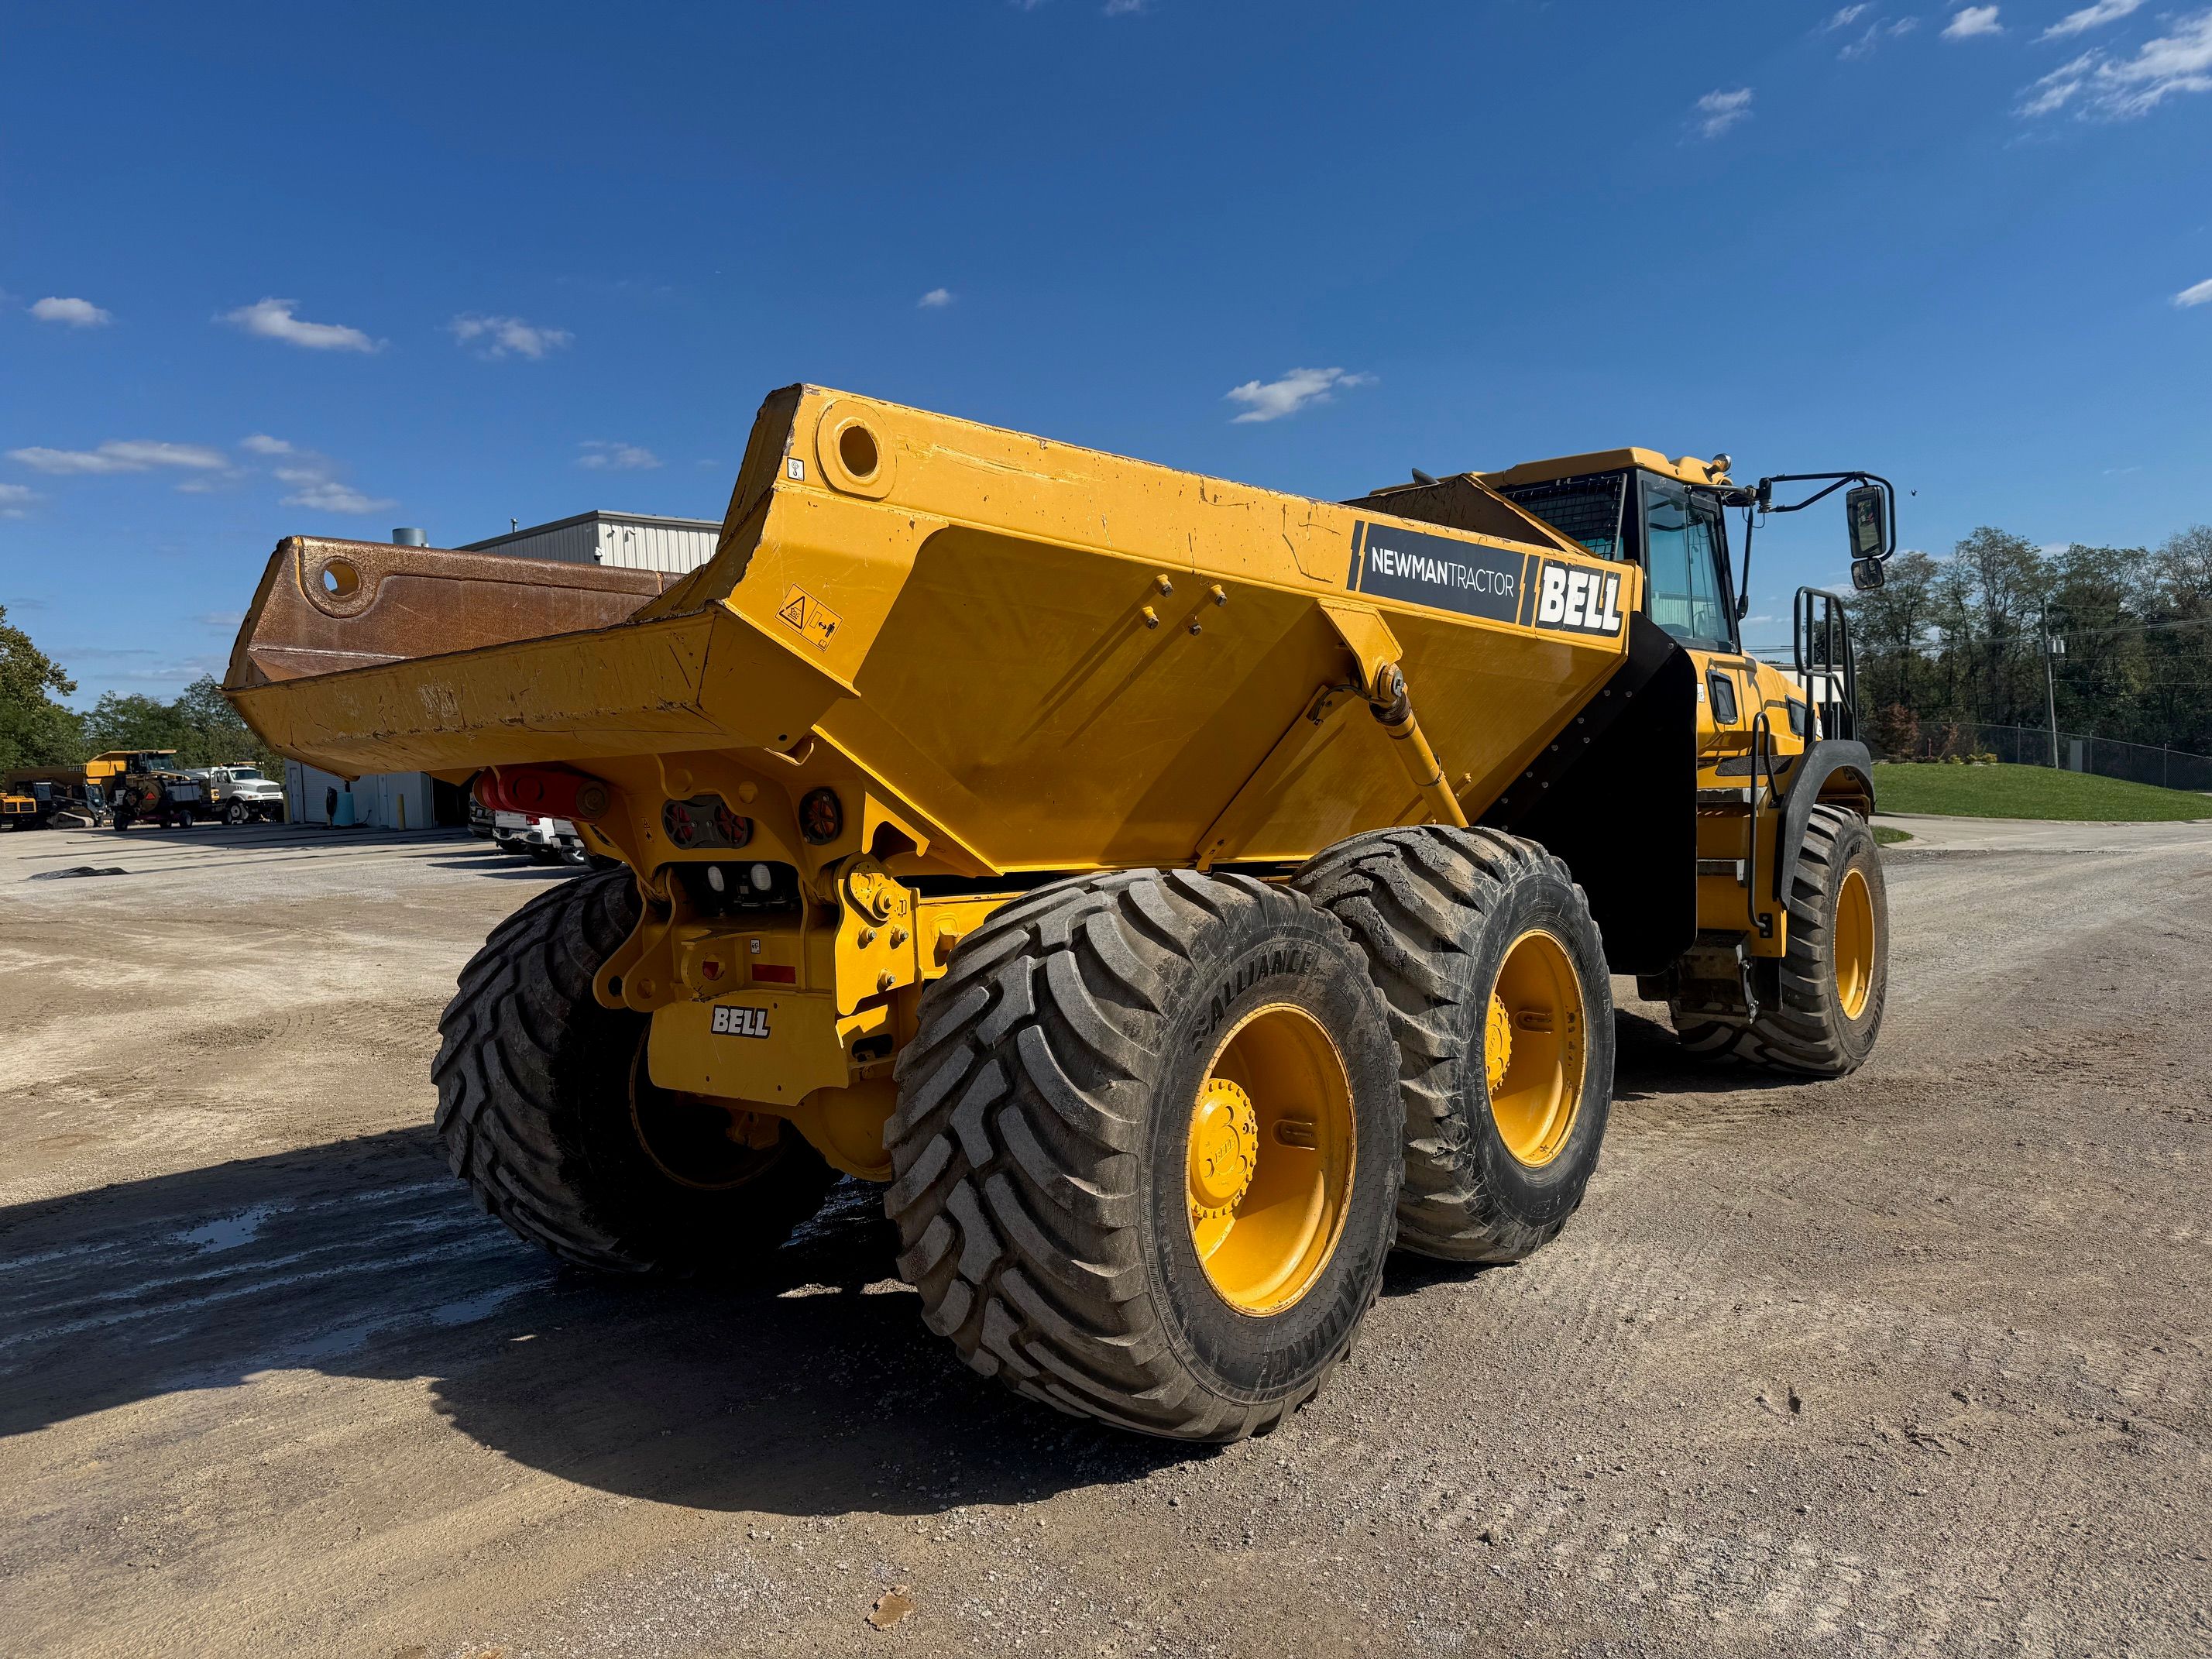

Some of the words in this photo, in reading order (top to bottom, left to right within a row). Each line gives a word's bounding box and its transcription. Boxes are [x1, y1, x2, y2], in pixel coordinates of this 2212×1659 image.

[1537, 565, 1621, 632] BELL
[712, 1007, 770, 1037] BELL
[1209, 948, 1314, 1036] ALLIANCE
[1258, 1267, 1359, 1389] ALLIANCE
